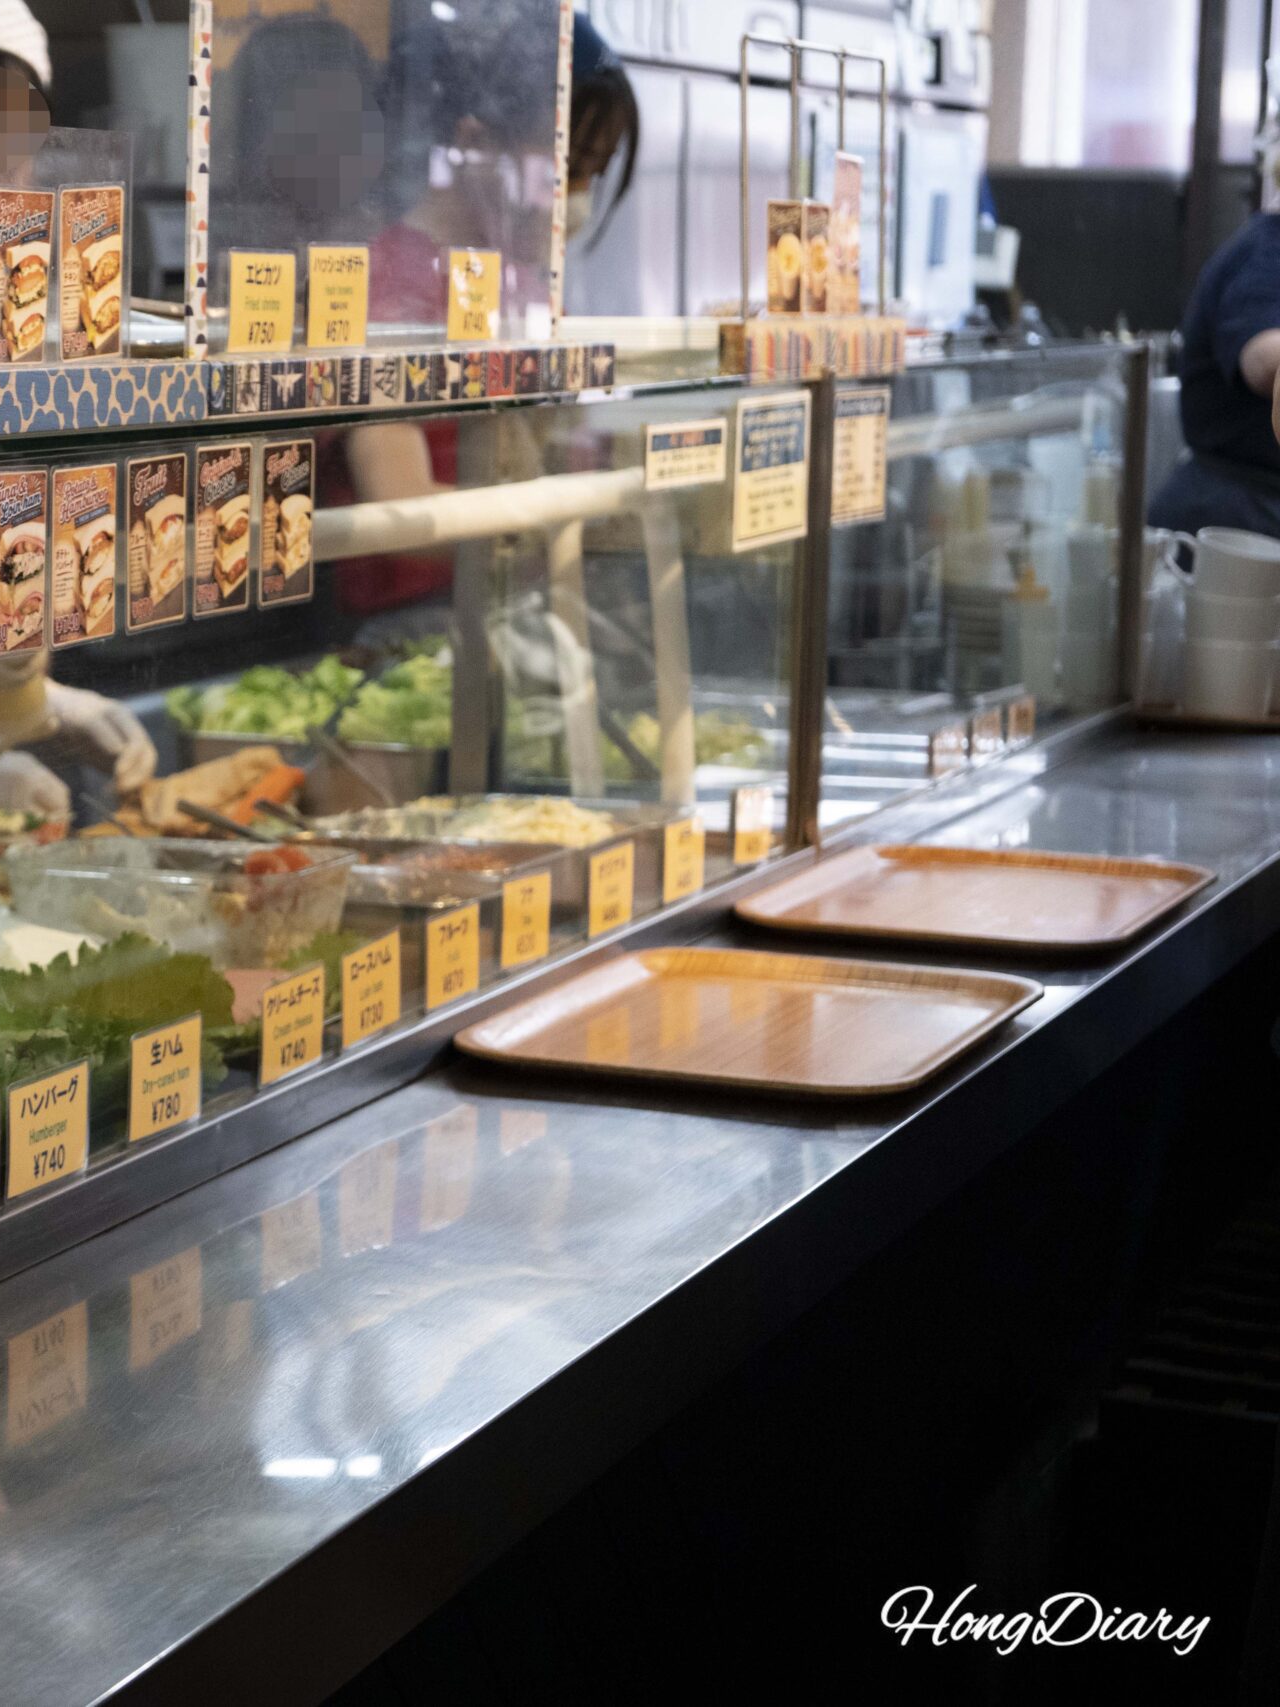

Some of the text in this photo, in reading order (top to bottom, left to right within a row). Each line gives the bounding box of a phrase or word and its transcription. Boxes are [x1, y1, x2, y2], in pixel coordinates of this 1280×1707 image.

[245, 264, 282, 286] エビカツ
[248, 321, 276, 344] ¥750
[350, 945, 392, 982] ロースハム
[266, 975, 321, 1017] クリームチーズ
[150, 1032, 184, 1067] 生ハム
[280, 1037, 308, 1068] ¥740
[20, 1074, 79, 1120] ハンバーグ
[152, 1091, 181, 1125] ¥780
[33, 1143, 66, 1179] ¥740
